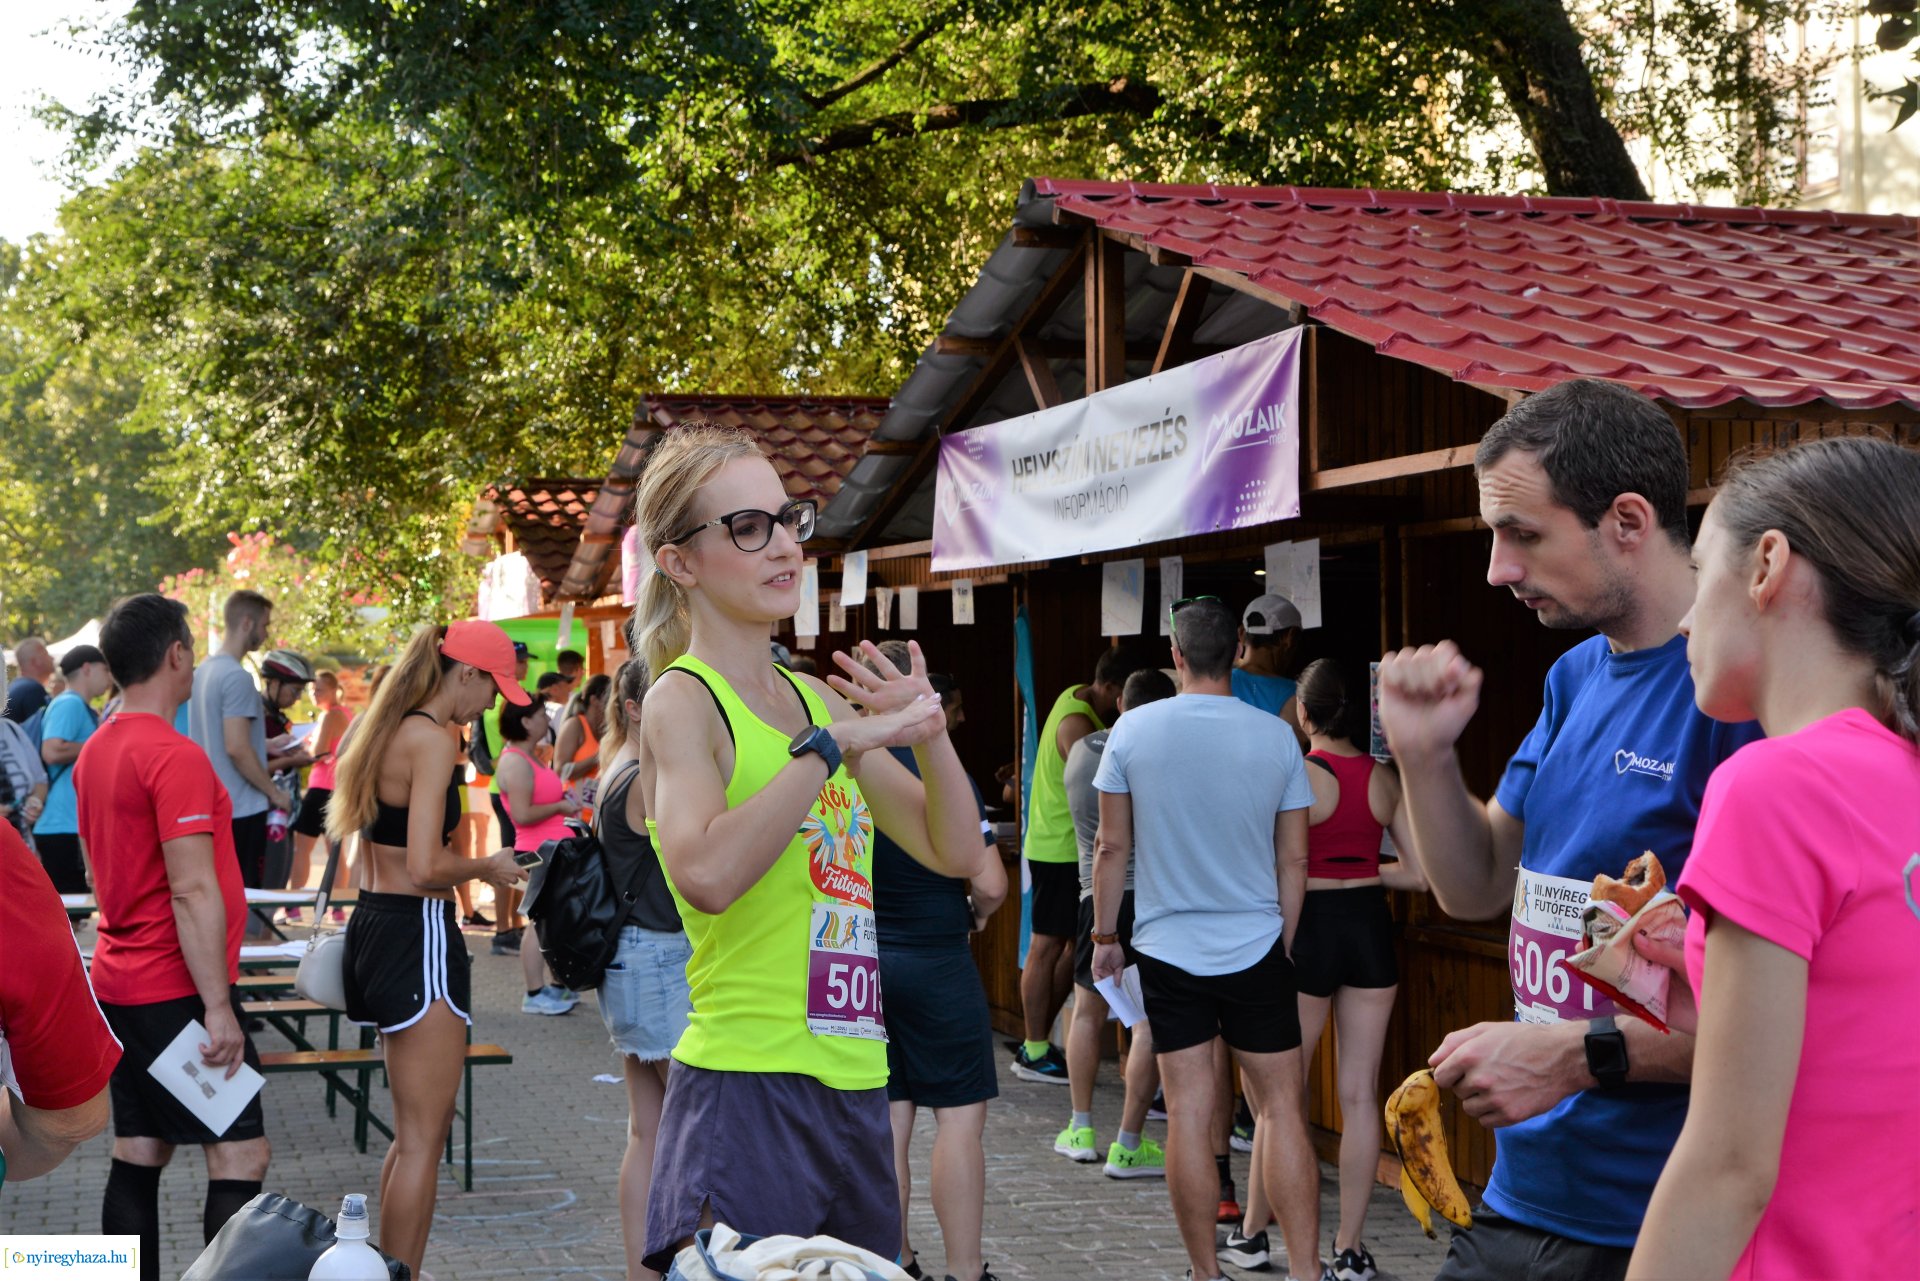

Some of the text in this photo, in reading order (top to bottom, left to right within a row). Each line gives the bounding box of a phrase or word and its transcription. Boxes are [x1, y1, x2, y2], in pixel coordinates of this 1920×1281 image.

[1093, 406, 1188, 475] NEVEZÉS
[1053, 477, 1129, 521] INFORMÁCIÓ
[1631, 756, 1676, 774] MOZAIK
[819, 781, 851, 816] Női
[1534, 883, 1592, 904] III.NYÍREG
